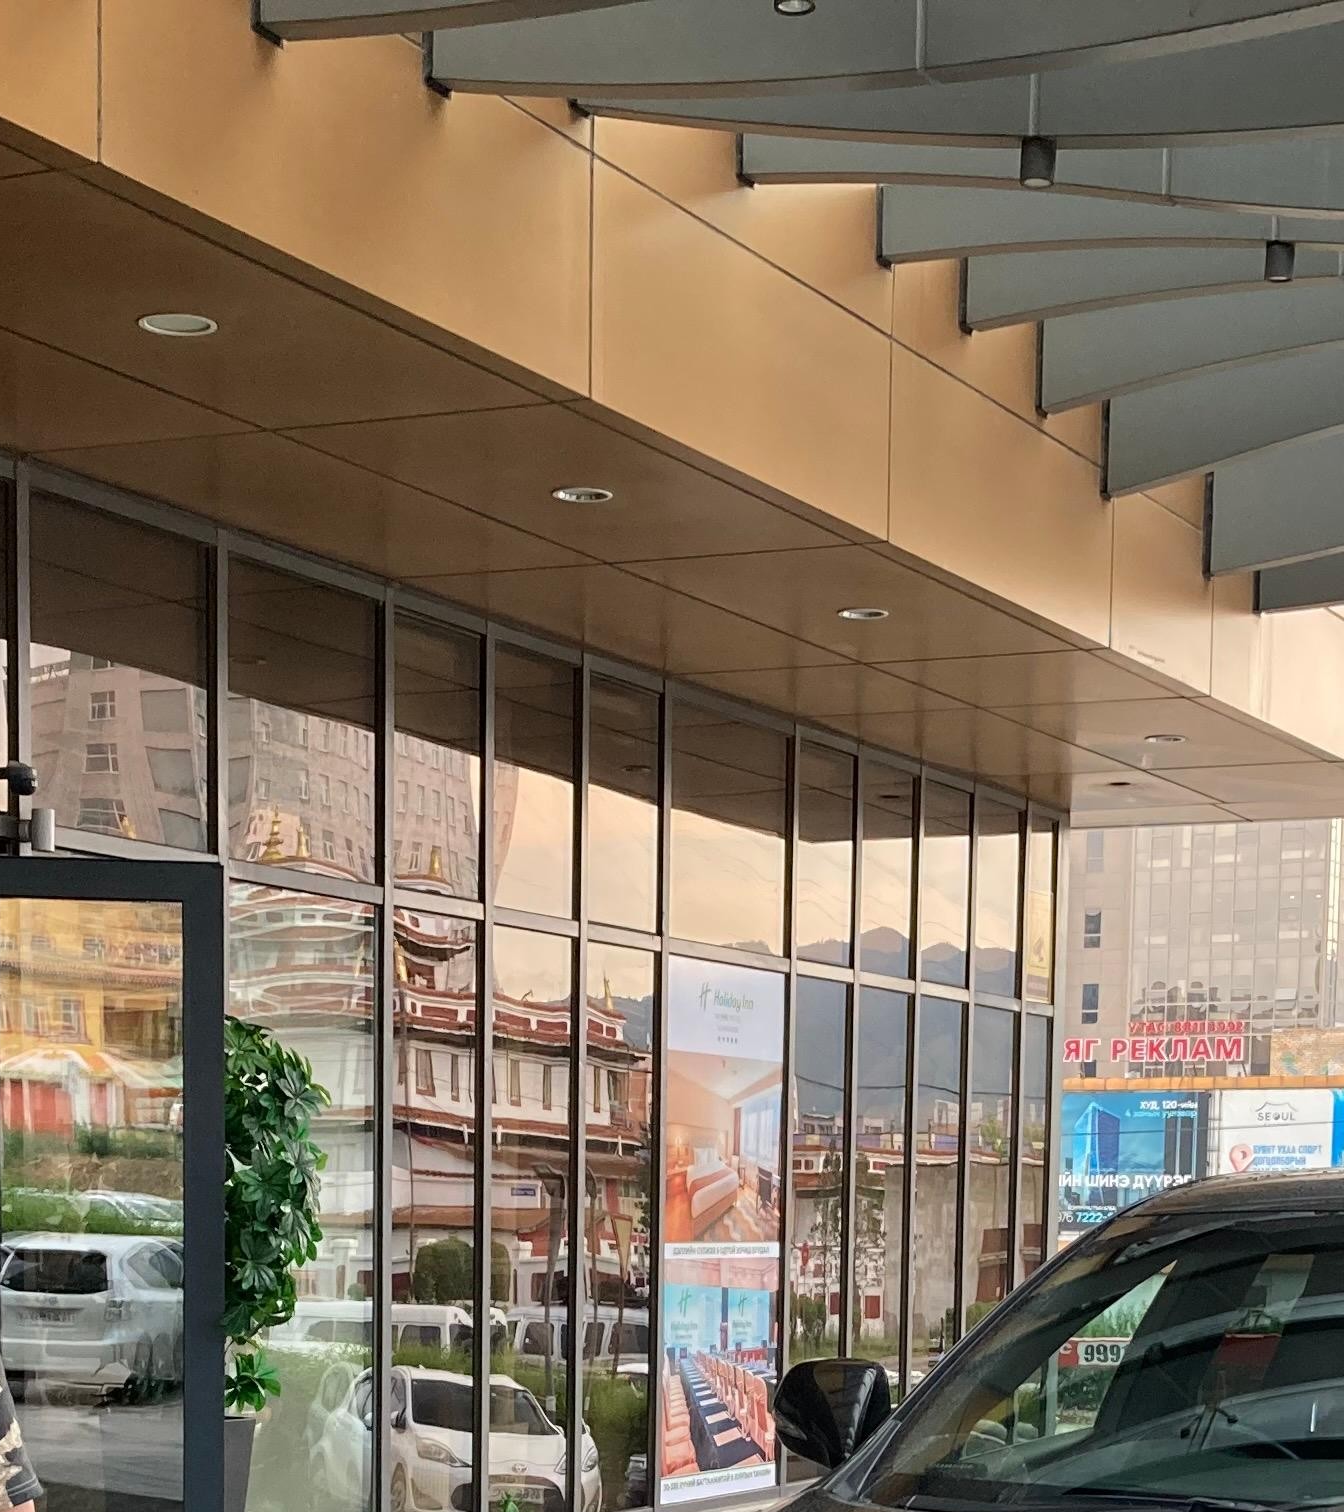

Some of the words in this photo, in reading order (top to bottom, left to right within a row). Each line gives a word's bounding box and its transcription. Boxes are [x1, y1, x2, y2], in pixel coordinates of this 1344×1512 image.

[1063, 1037, 1102, 1062] ЯГ
[1110, 1036, 1245, 1062] РЕКЛАМ
[1257, 1111, 1296, 1121] SEOUL
[1085, 1174, 1130, 1187] ШИНЭ
[1084, 1343, 1123, 1363] 999
